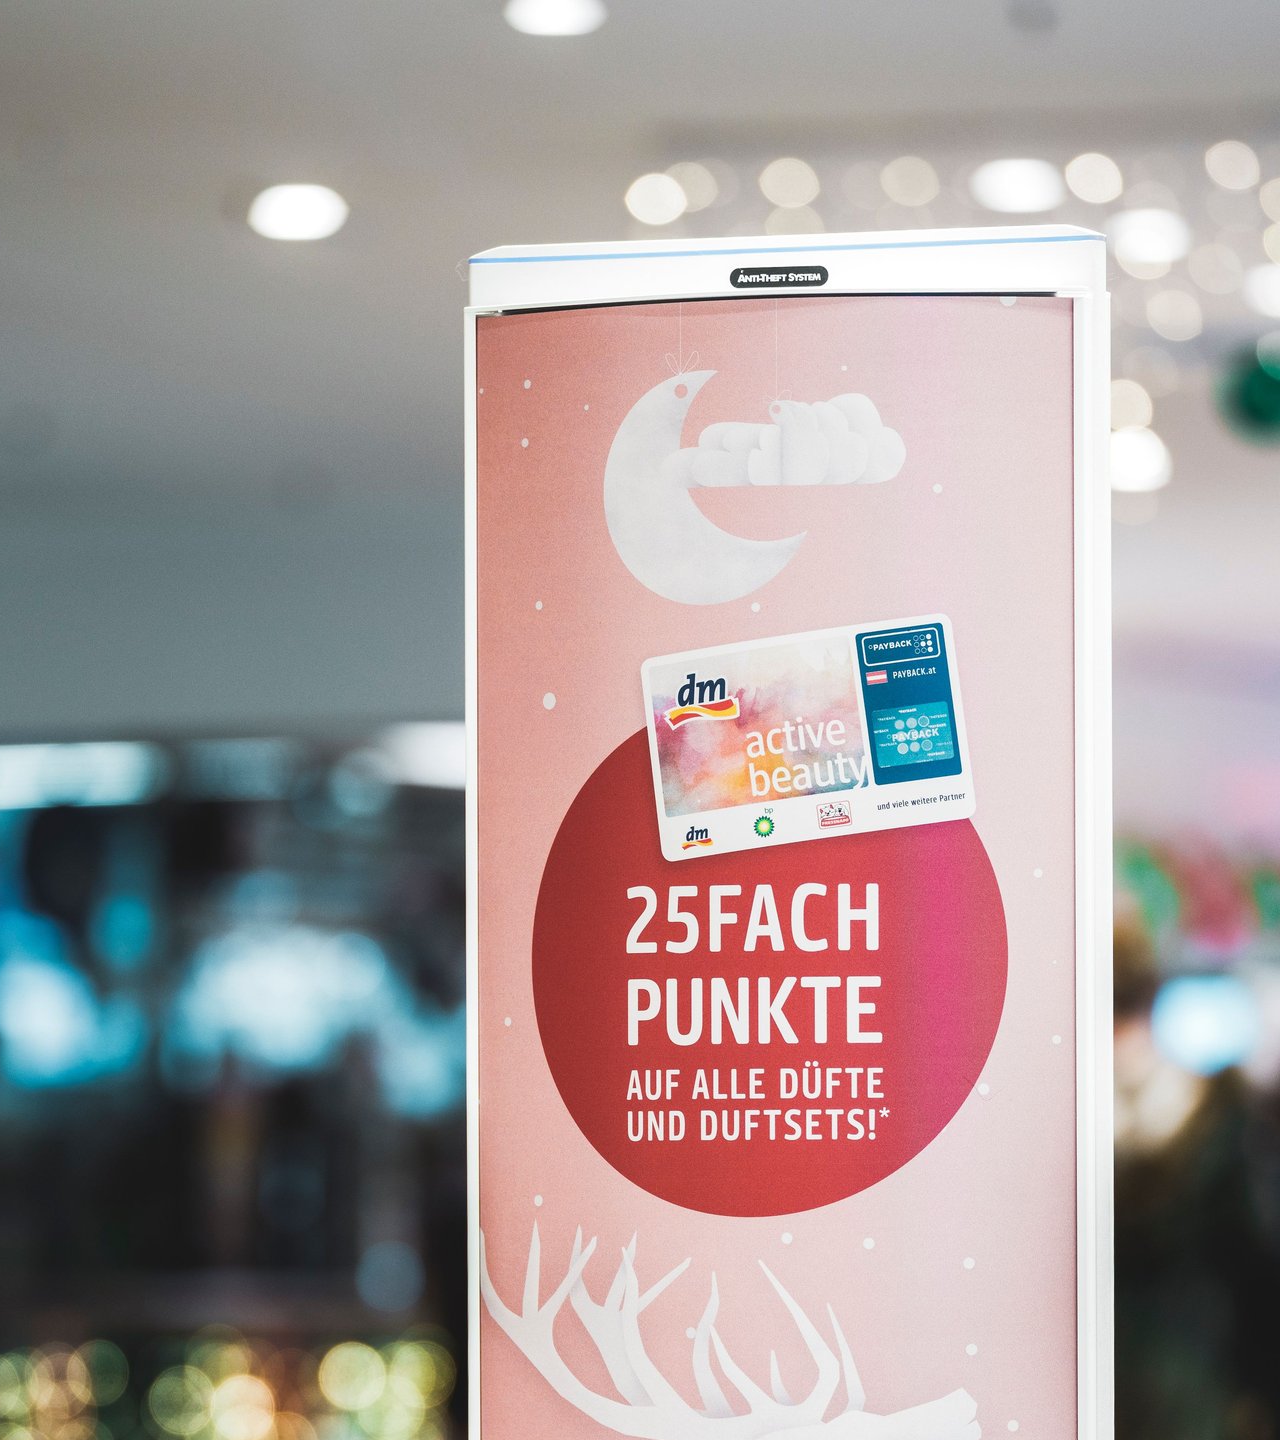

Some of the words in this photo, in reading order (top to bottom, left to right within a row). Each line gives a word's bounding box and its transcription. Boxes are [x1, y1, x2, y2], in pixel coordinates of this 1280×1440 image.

[788, 272, 821, 282] SYSTEM
[873, 640, 912, 651] PAYBACK
[892, 666, 937, 680] PAYBACK.at
[677, 673, 726, 708] dm
[745, 716, 846, 759] active
[892, 728, 939, 742] PAYBACK
[748, 751, 869, 797] beauty
[877, 802, 890, 810] und
[892, 800, 909, 808] viele
[911, 797, 938, 806] weitere
[939, 792, 966, 802] Partner
[686, 826, 708, 842] dm
[626, 882, 880, 954] 25FACH
[627, 976, 883, 1046] PUNKTE
[626, 1069, 680, 1100] AUF
[692, 1068, 766, 1100] ALLE
[780, 1061, 884, 1099] DÜFTE
[627, 1110, 686, 1142] UND
